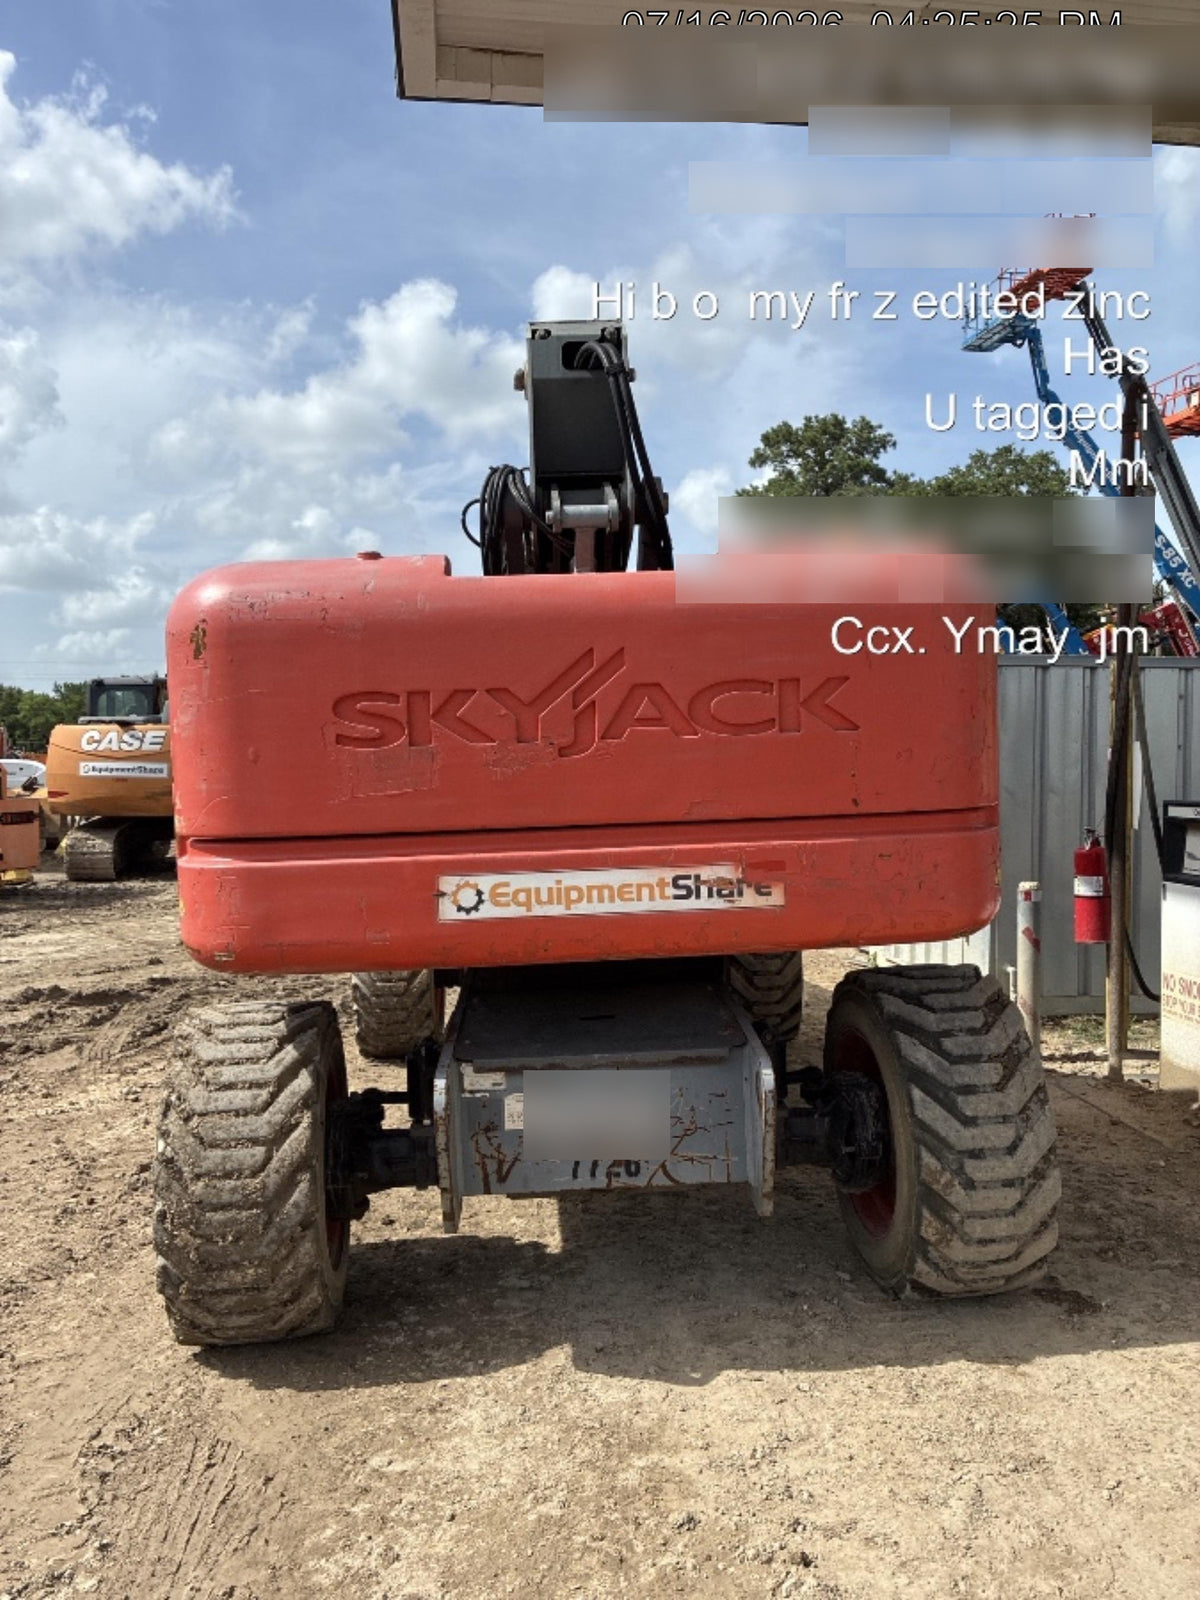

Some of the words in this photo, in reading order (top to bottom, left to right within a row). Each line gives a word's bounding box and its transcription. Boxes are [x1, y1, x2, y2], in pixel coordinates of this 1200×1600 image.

[330, 646, 861, 759] SKYJACK
[80, 729, 167, 752] CASE
[488, 872, 774, 912] EquipmentShare
